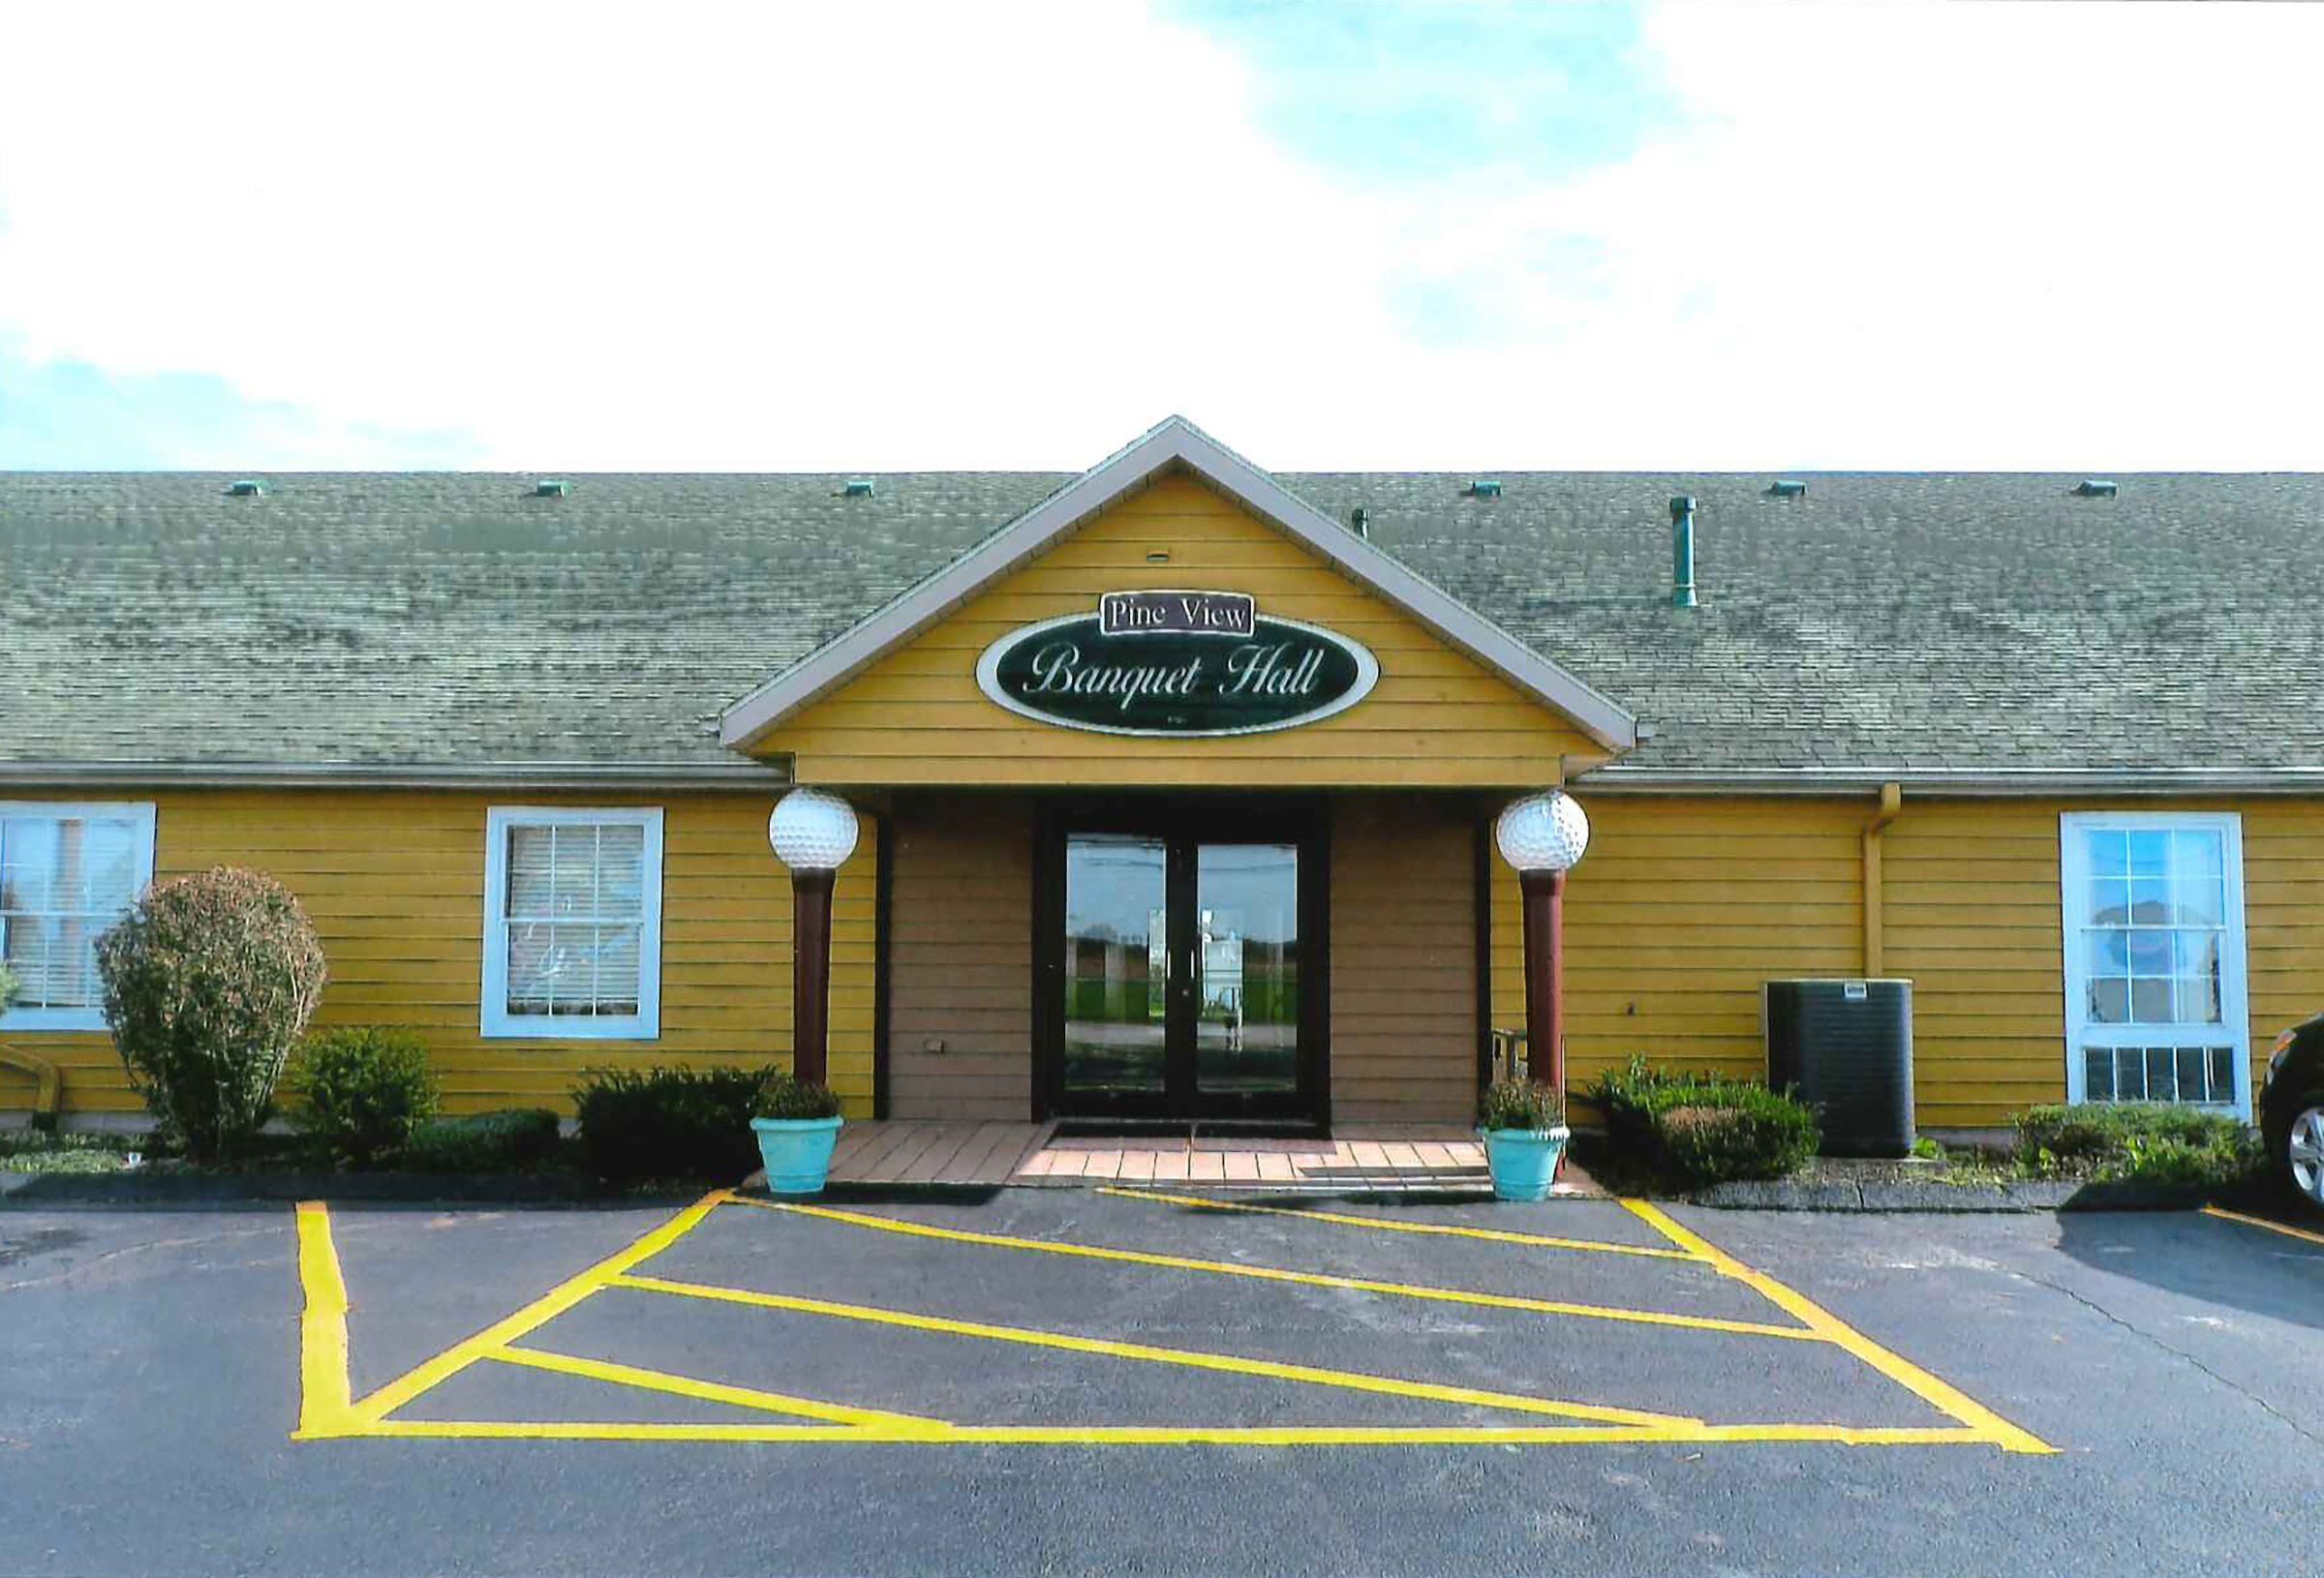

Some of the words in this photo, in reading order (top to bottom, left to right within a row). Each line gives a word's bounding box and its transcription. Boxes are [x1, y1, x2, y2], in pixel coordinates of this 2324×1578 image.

[1111, 599, 1167, 627] Pine
[1181, 600, 1248, 629] View
[1024, 644, 1202, 710] Banquet
[1220, 645, 1325, 694] Hall
